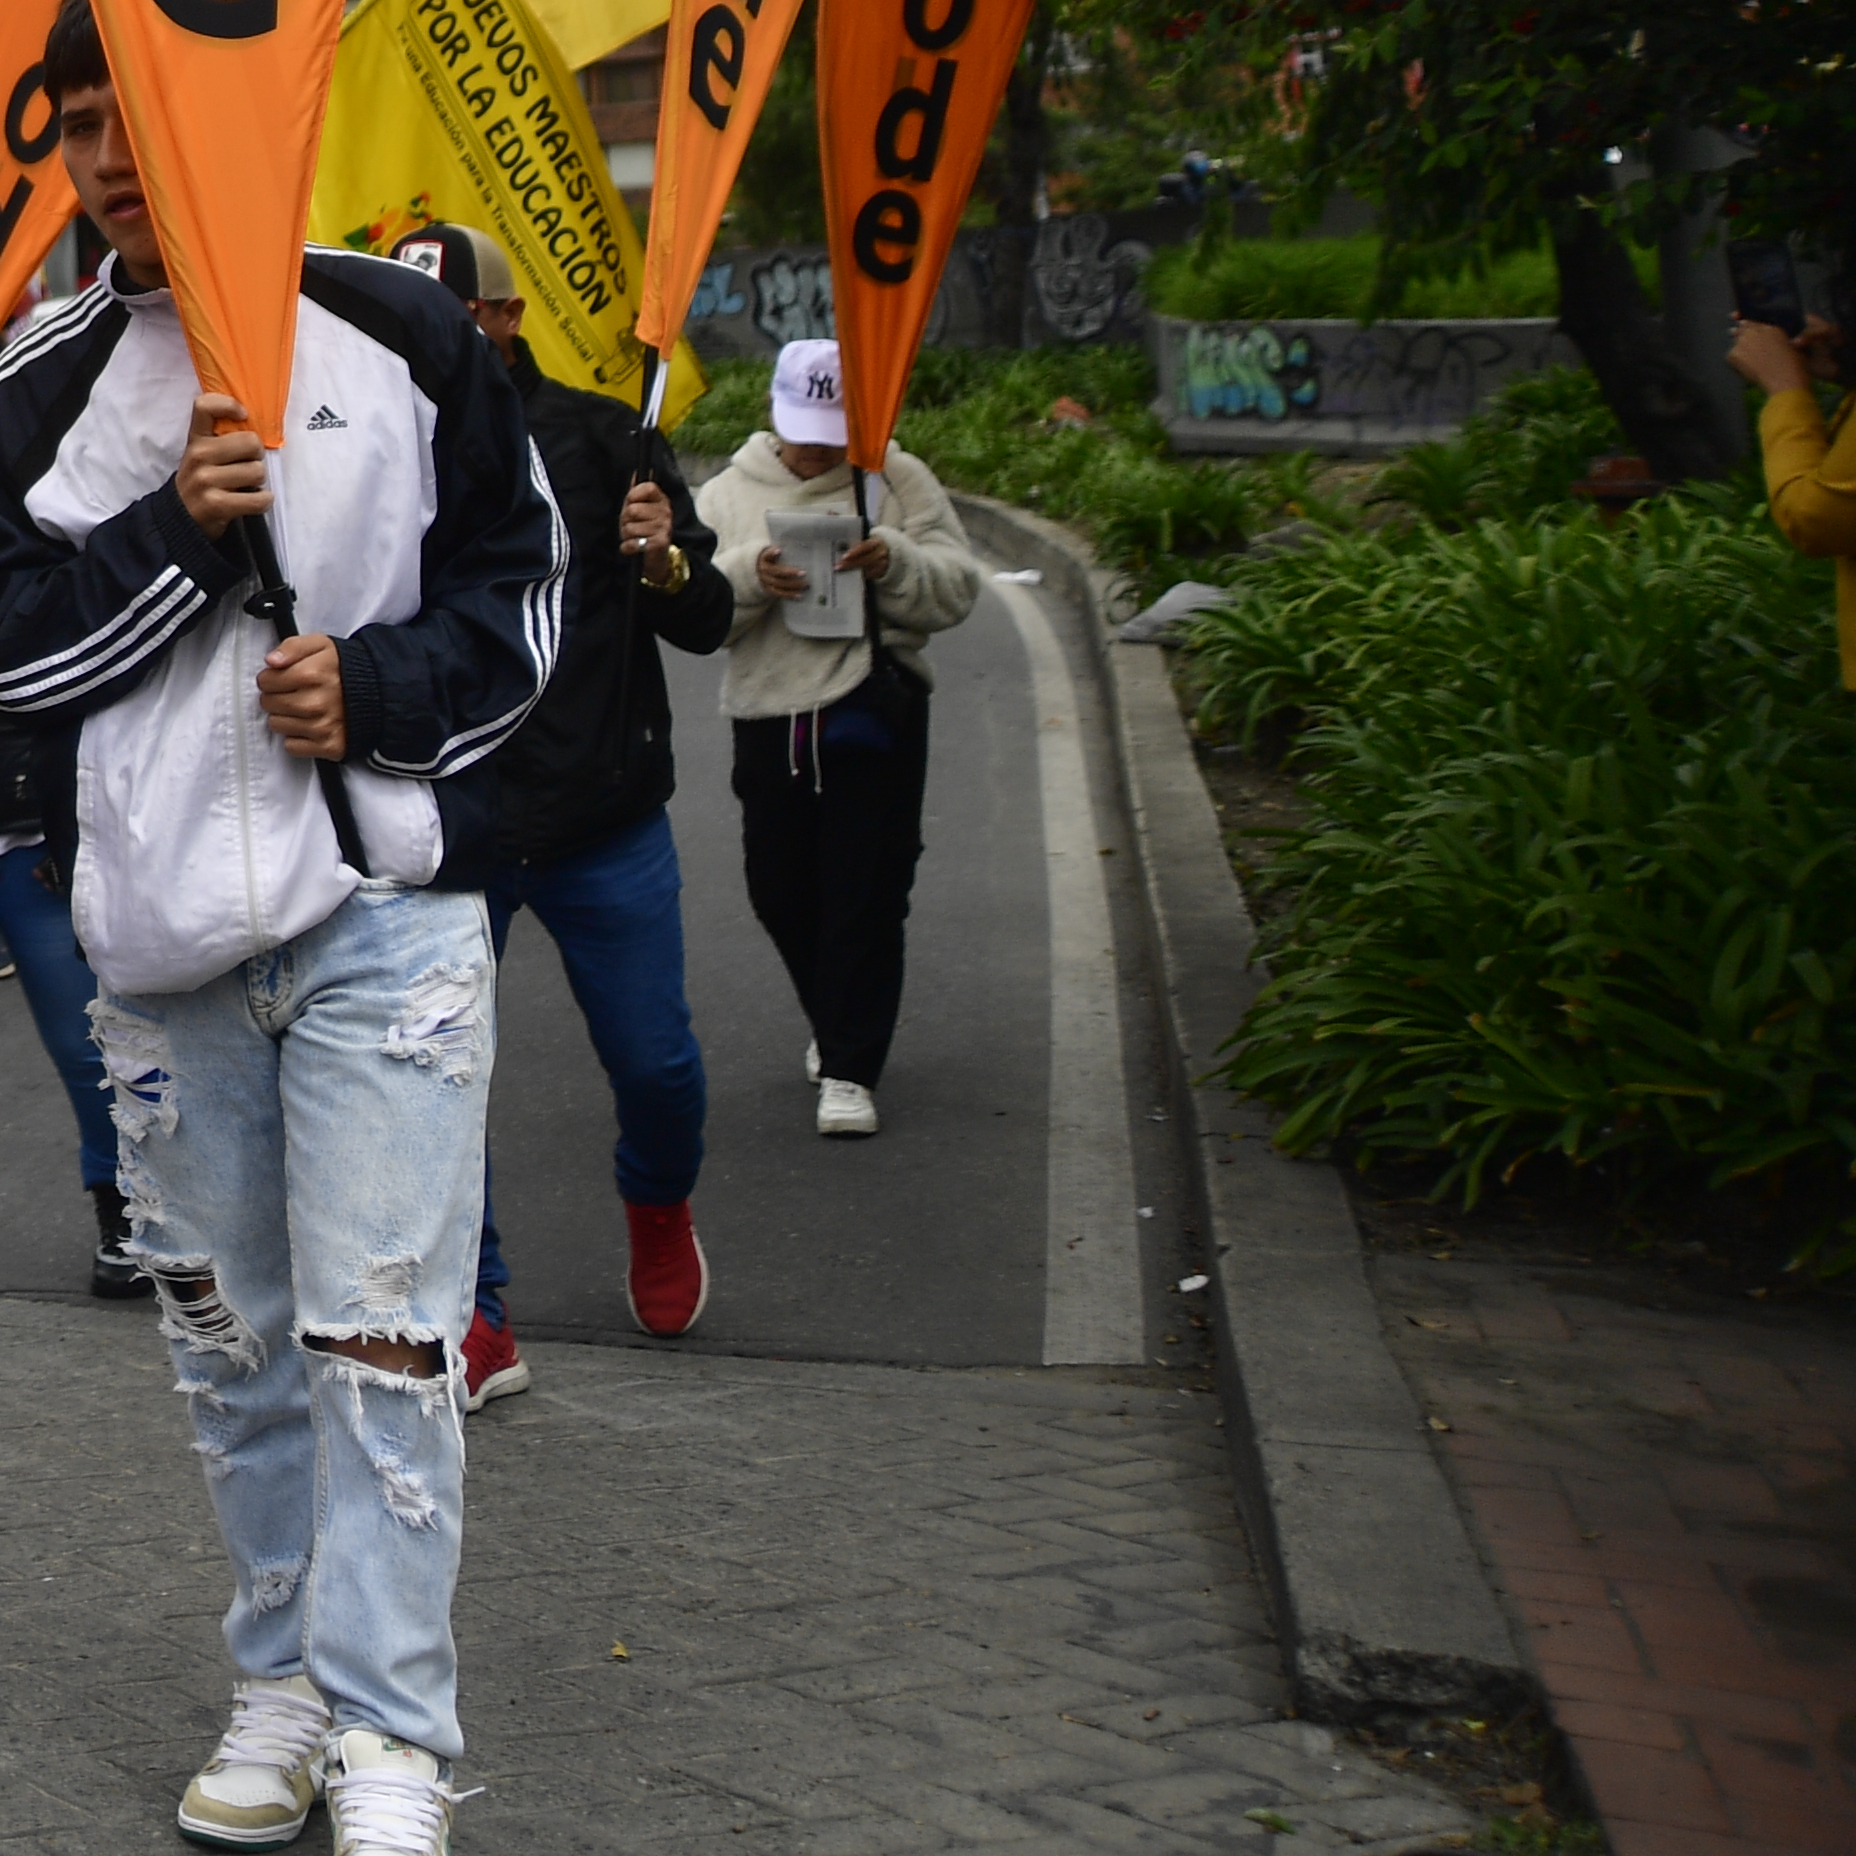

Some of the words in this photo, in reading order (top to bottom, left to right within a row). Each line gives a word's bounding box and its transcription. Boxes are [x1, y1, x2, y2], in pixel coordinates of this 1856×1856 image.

[457, 63, 496, 119] LA
[484, 115, 613, 317] EDUCACIÓN
[459, 152, 484, 188] para
[491, 203, 561, 318] Transformación
[559, 315, 594, 362] Social
[306, 419, 348, 431] adidas
